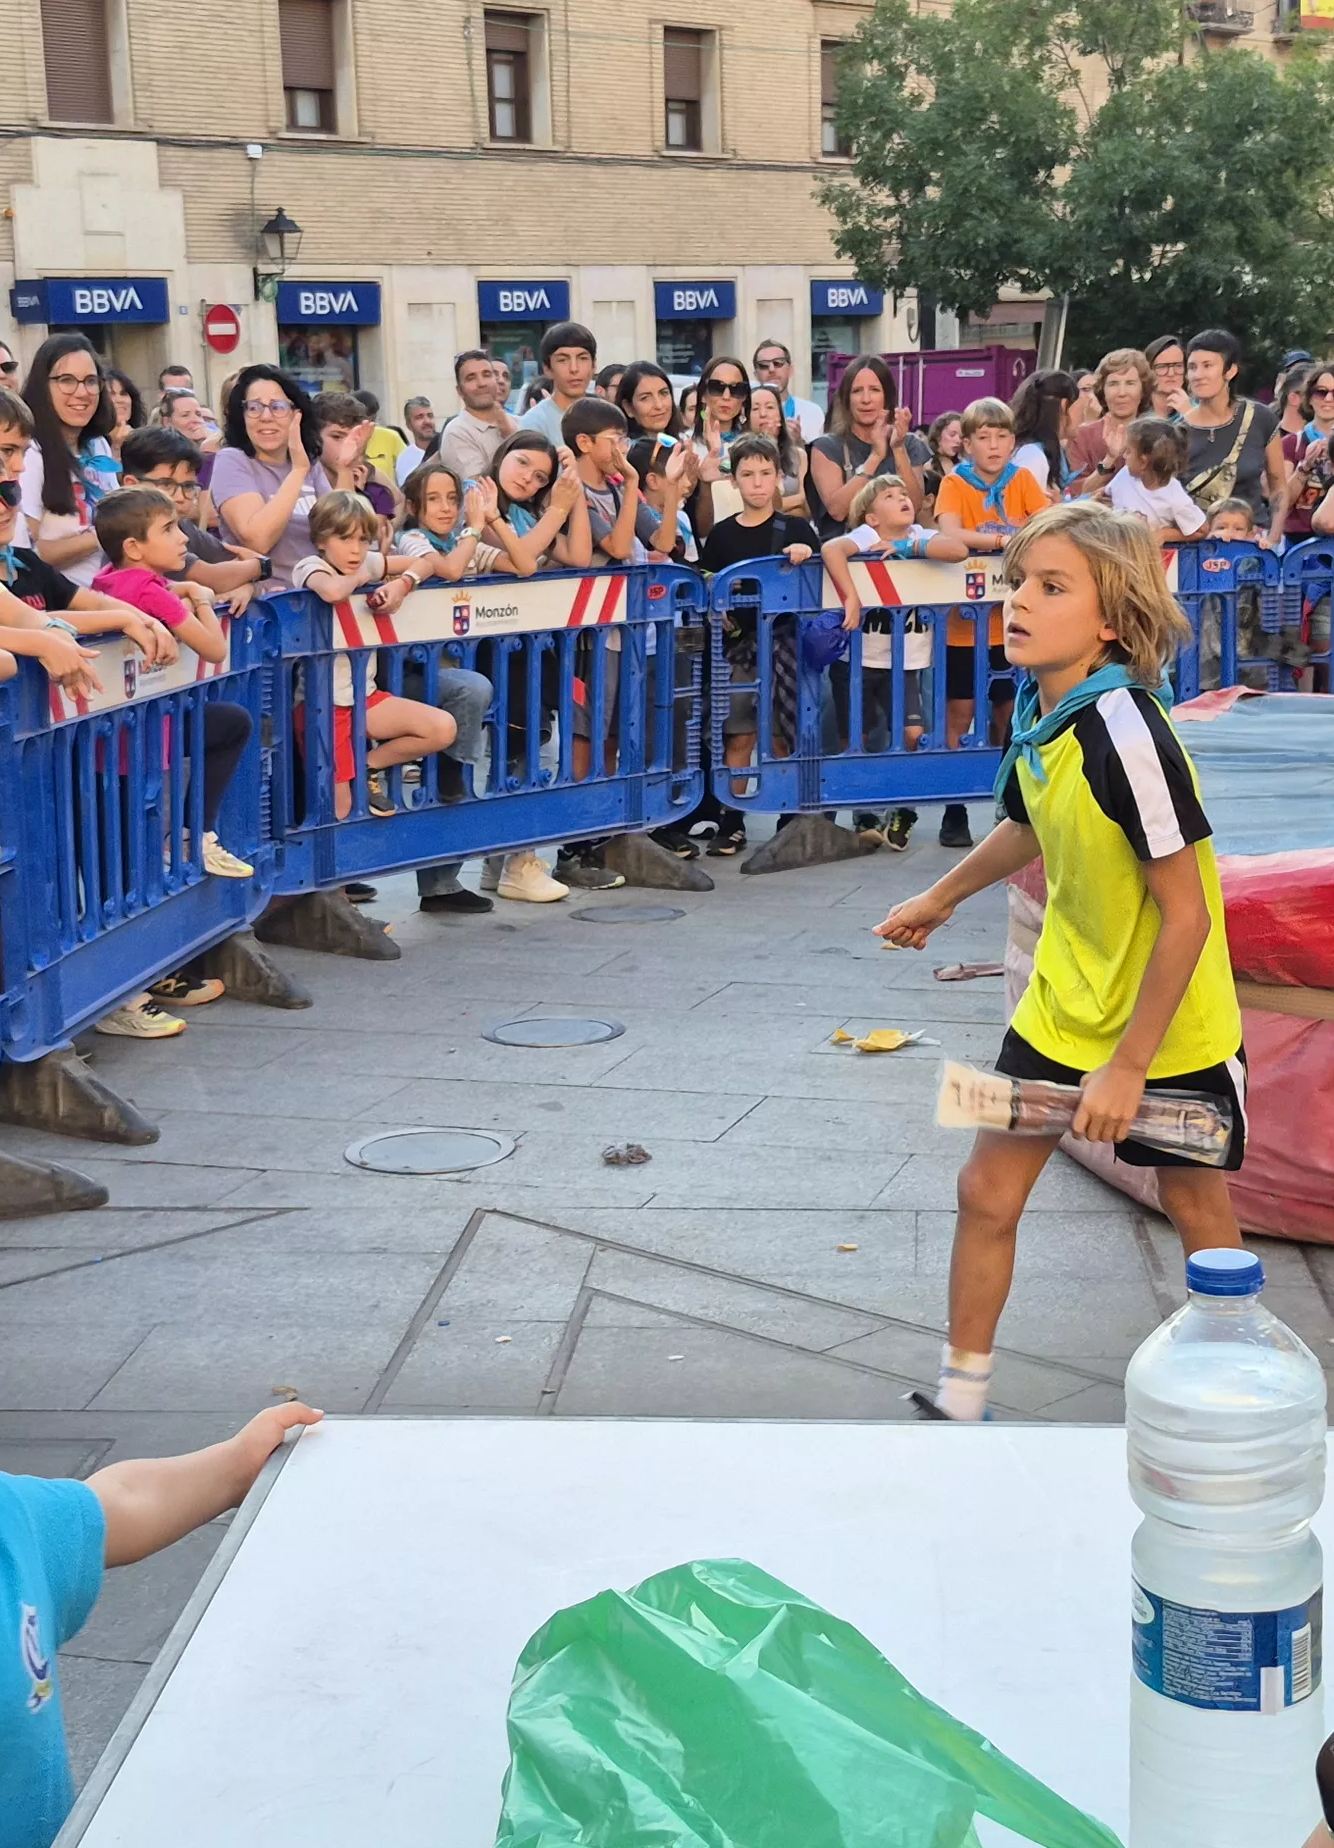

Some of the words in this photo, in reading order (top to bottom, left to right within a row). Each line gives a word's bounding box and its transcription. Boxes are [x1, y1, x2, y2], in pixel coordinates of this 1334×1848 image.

[74, 287, 144, 314] BBVA
[299, 291, 359, 315] BBVA
[499, 288, 551, 312] BBVA
[673, 288, 719, 311] BBVA
[827, 287, 868, 308] BBVA
[1206, 560, 1228, 570] JSP
[475, 604, 519, 618] Monzón
